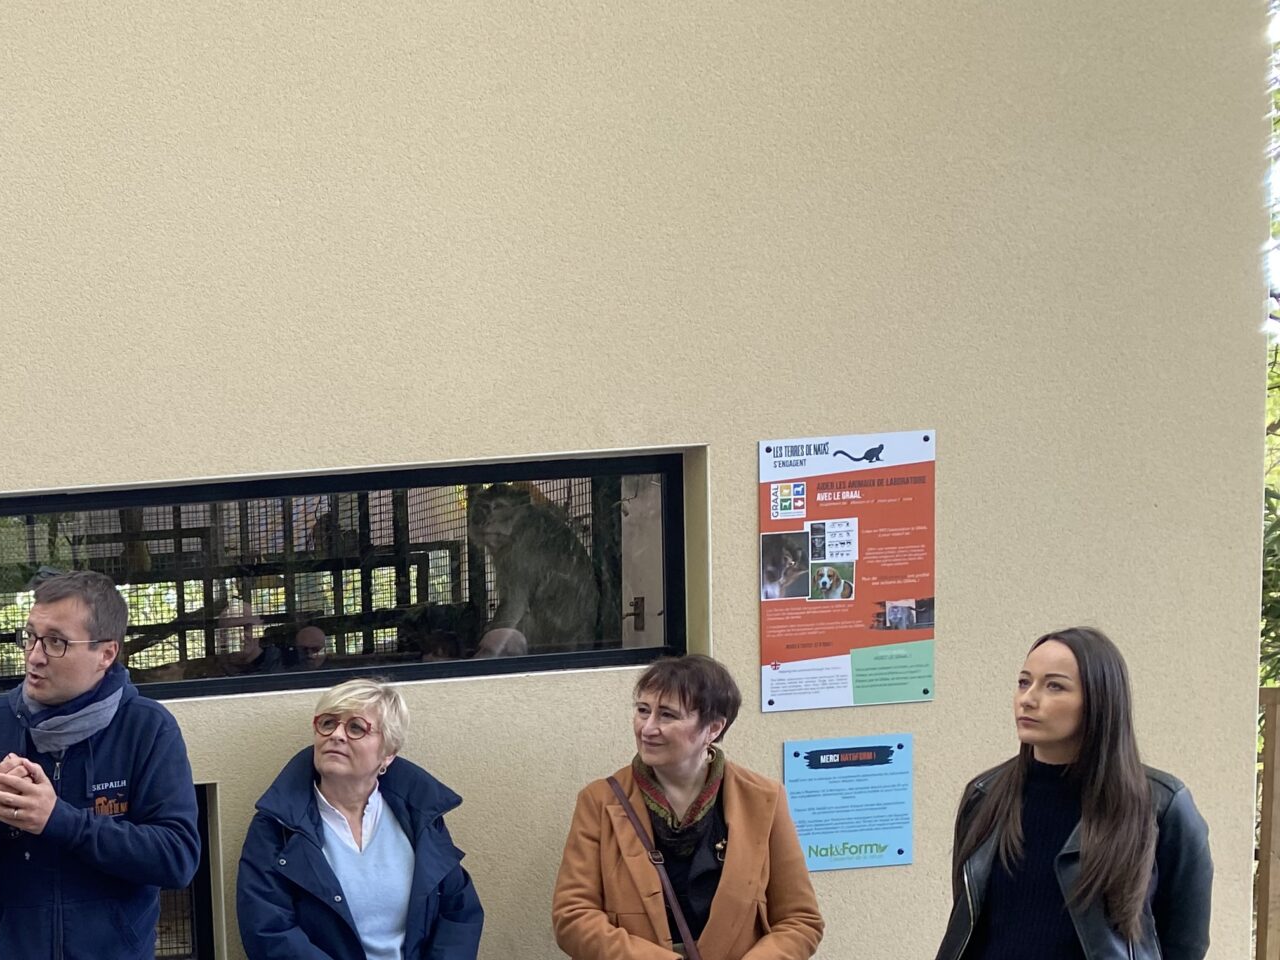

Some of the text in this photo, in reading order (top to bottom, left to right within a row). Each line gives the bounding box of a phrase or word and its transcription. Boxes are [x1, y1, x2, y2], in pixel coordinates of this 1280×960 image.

[773, 446, 783, 458] LES
[784, 445, 804, 457] TERRES
[805, 443, 812, 456] DE
[773, 459, 807, 468] S'ENGAGENT
[835, 481, 846, 490] LES
[848, 479, 876, 489] ANIMAUX
[877, 478, 885, 487] DE
[771, 485, 779, 518] GRAAL
[816, 489, 862, 502] AVEC LE GRAAL
[820, 754, 839, 763] MERCI
